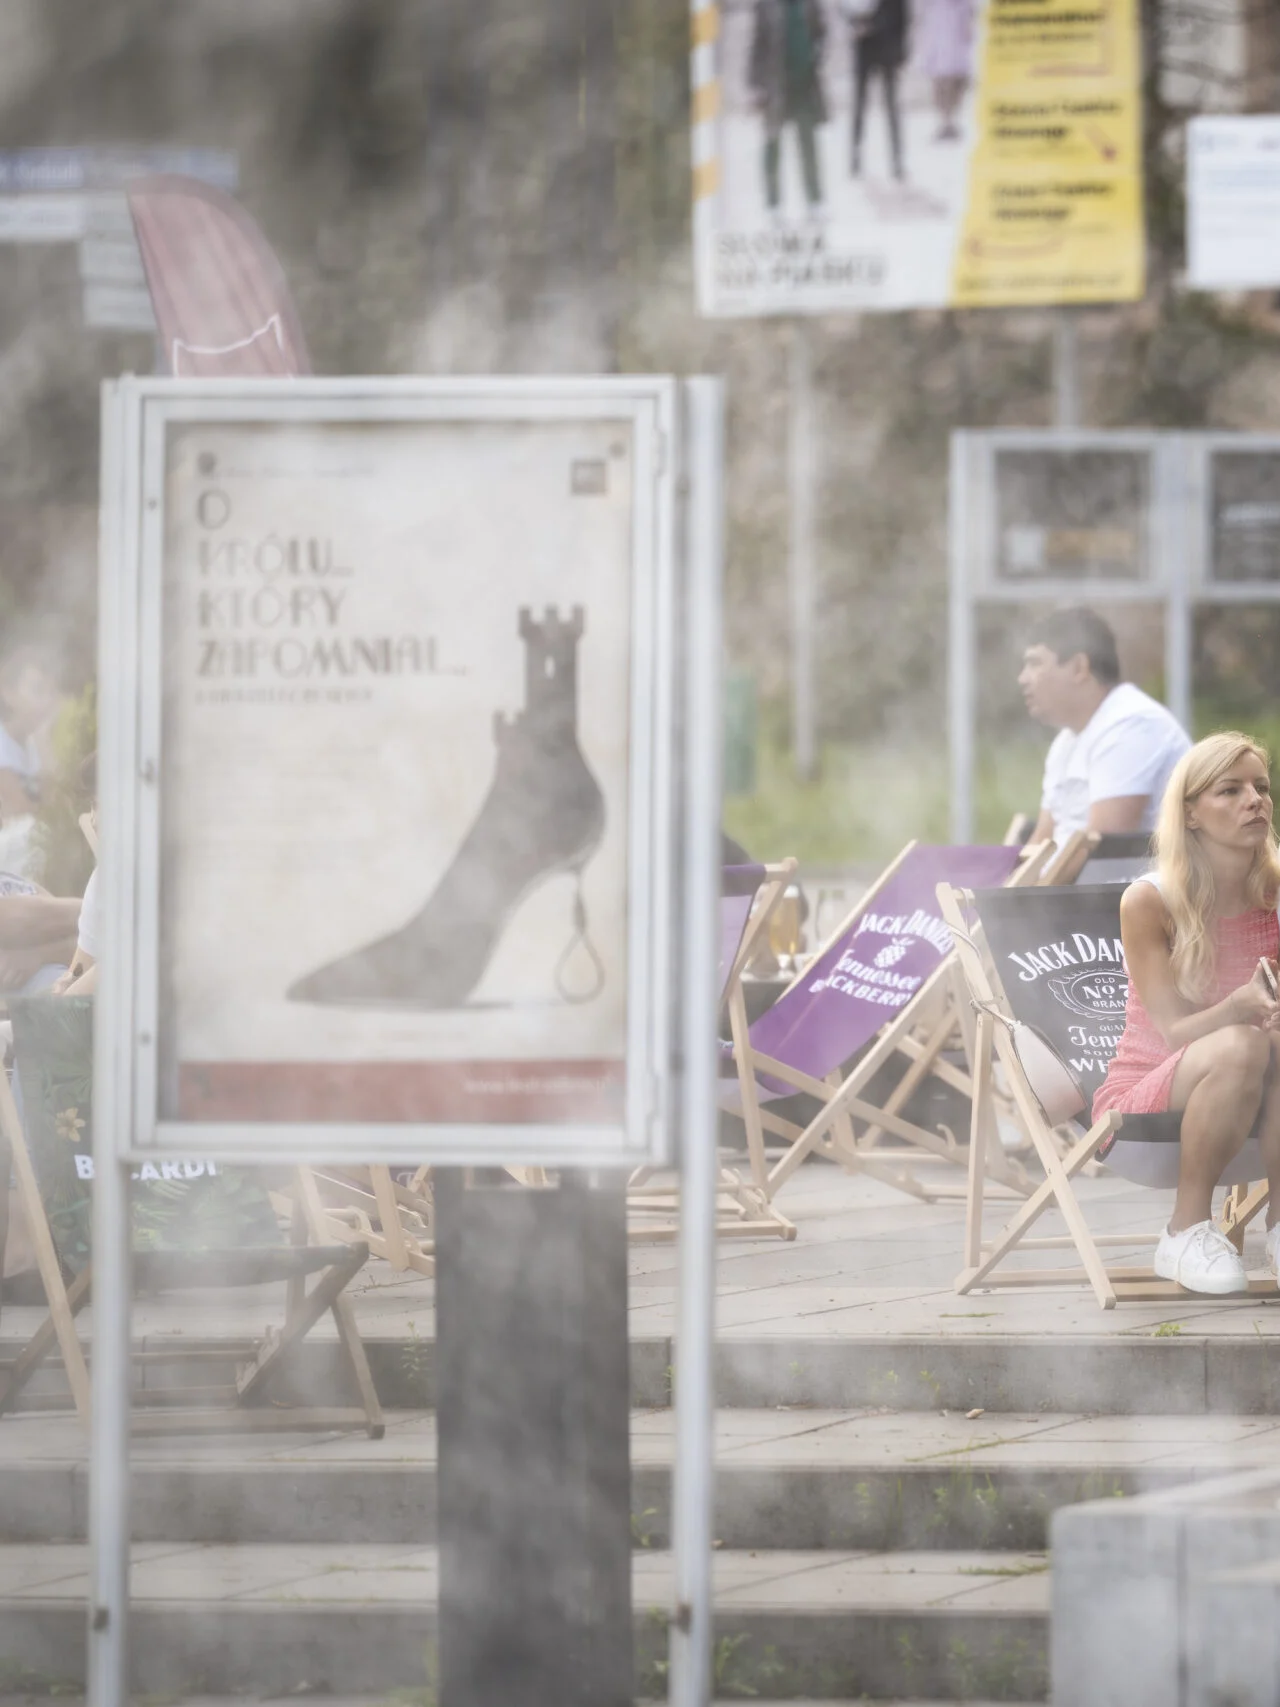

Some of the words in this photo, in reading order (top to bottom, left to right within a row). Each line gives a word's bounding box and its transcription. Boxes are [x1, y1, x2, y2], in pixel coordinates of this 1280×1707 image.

[195, 488, 232, 531] O
[1008, 941, 1079, 982] JACK
[1071, 933, 1126, 964] DAN
[1094, 977, 1116, 985] OLD
[1092, 1000, 1127, 1009] BRAN
[1099, 1024, 1126, 1032] QUAL
[1068, 1024, 1122, 1049] Tenn
[1069, 1058, 1110, 1074] WH
